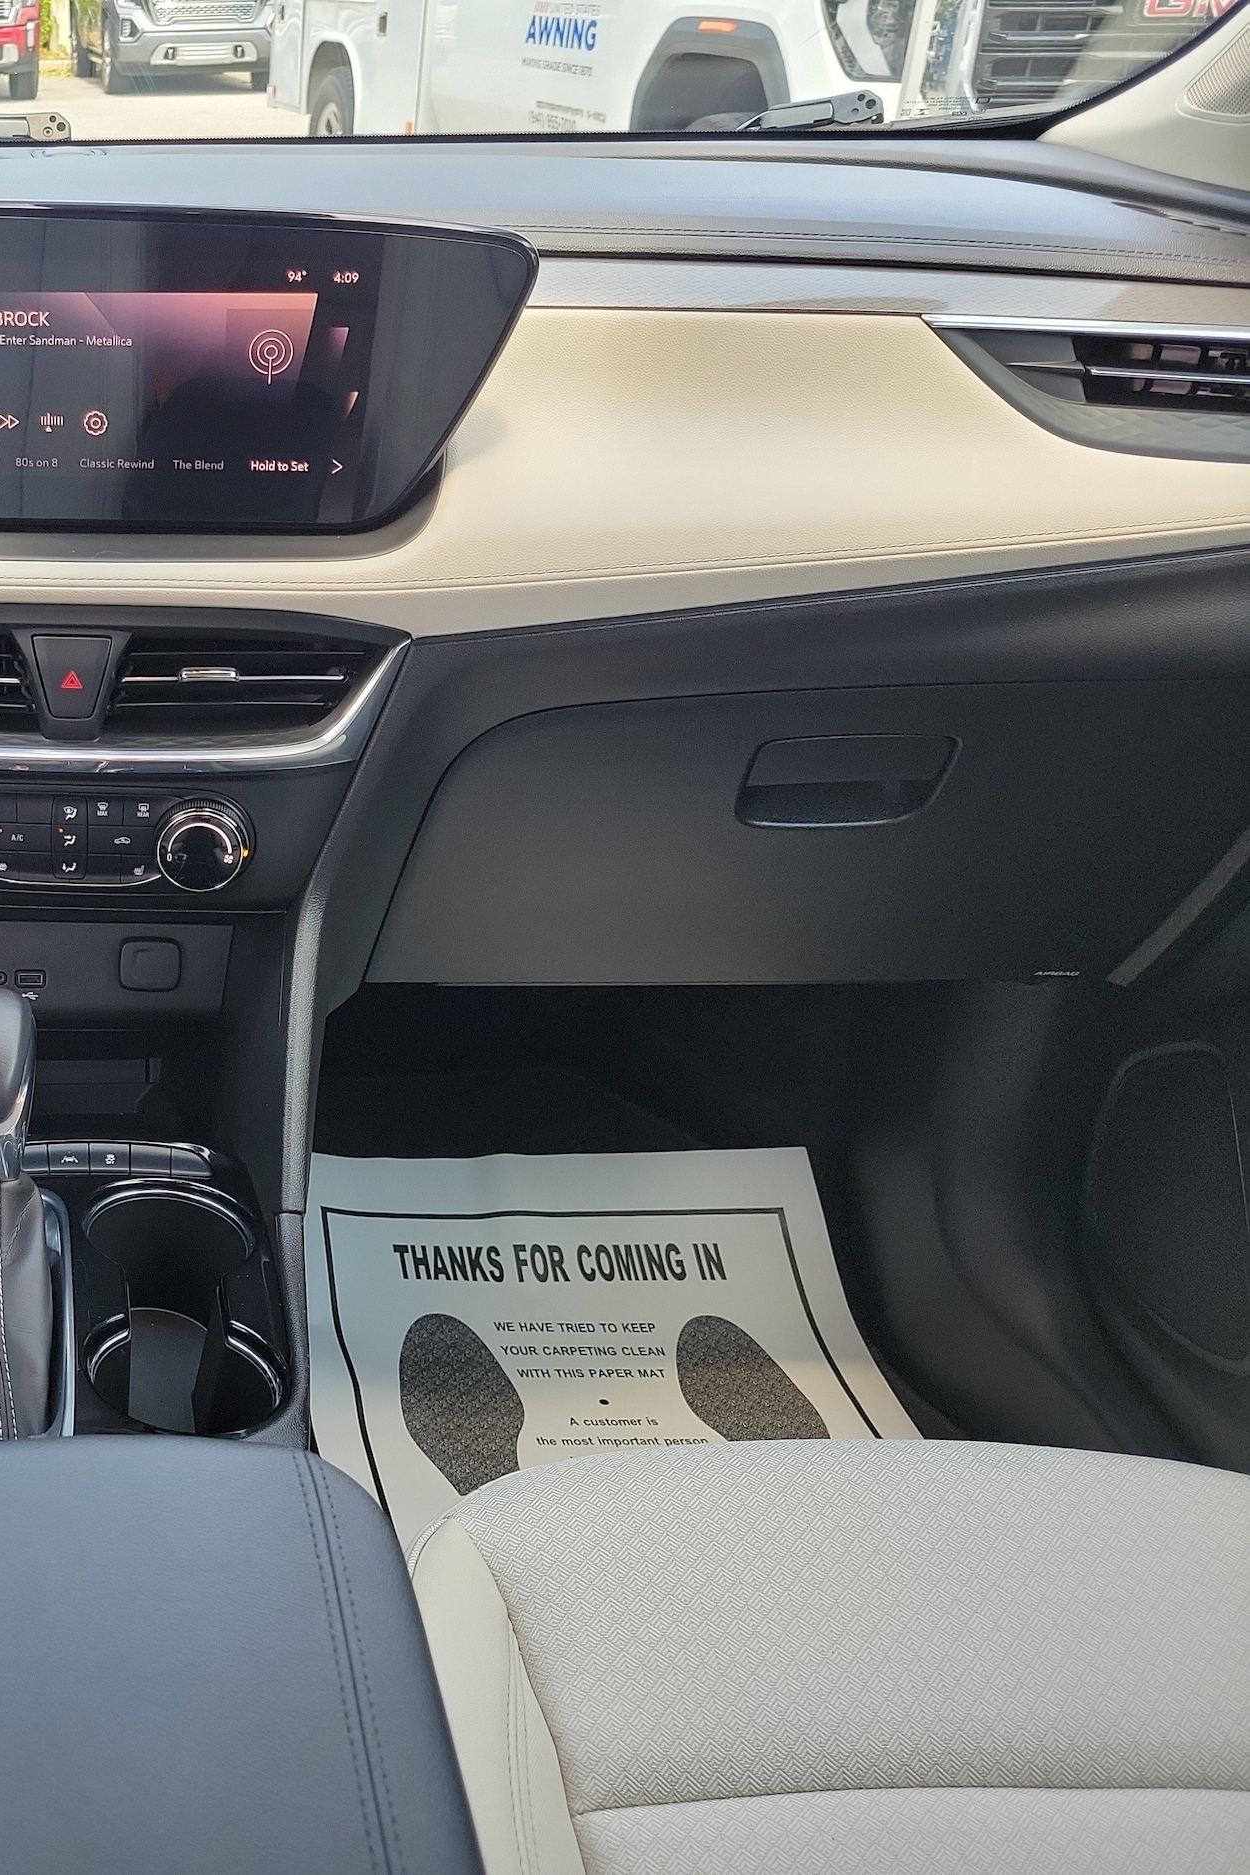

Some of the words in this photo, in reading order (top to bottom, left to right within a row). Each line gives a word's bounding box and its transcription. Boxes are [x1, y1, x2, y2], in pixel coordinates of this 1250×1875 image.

[525, 15, 597, 51] AWNING
[287, 271, 307, 283] 94°
[333, 272, 359, 284] 4:09
[0, 335, 27, 346] Enter
[29, 334, 76, 346] Sandman
[86, 335, 133, 347] Metallica
[15, 457, 34, 467] 80s
[36, 460, 49, 468] on
[51, 458, 58, 468] 8
[79, 458, 115, 469] Classic
[117, 458, 154, 470] Rewind
[173, 460, 192, 470] The
[194, 460, 224, 471] Blend
[250, 460, 275, 472] Hold
[277, 461, 289, 472] to
[290, 461, 309, 472] Set
[97, 810, 109, 818] MAX
[10, 833, 24, 842] A/C
[393, 1244, 505, 1283] THANKS
[512, 1243, 570, 1283] FOR
[577, 1243, 687, 1283] COMING
[692, 1242, 727, 1282] IN
[493, 1321, 515, 1332] WE
[519, 1322, 554, 1332] HAVE
[557, 1322, 595, 1333] TRIED
[599, 1323, 618, 1333] TO
[622, 1323, 656, 1333] KEEP
[500, 1345, 538, 1356] YOUR
[542, 1346, 617, 1357] CARPETING
[622, 1346, 666, 1357] CLEAN
[517, 1368, 551, 1378] WITH
[554, 1368, 584, 1378] THIS
[589, 1368, 633, 1378] PAPER
[638, 1368, 665, 1379] MAT
[569, 1417, 580, 1426] A
[583, 1418, 642, 1427] customer
[646, 1416, 659, 1427] is
[536, 1436, 557, 1446] the
[561, 1438, 594, 1446] most
[596, 1436, 660, 1447] important
[663, 1438, 709, 1447] person
